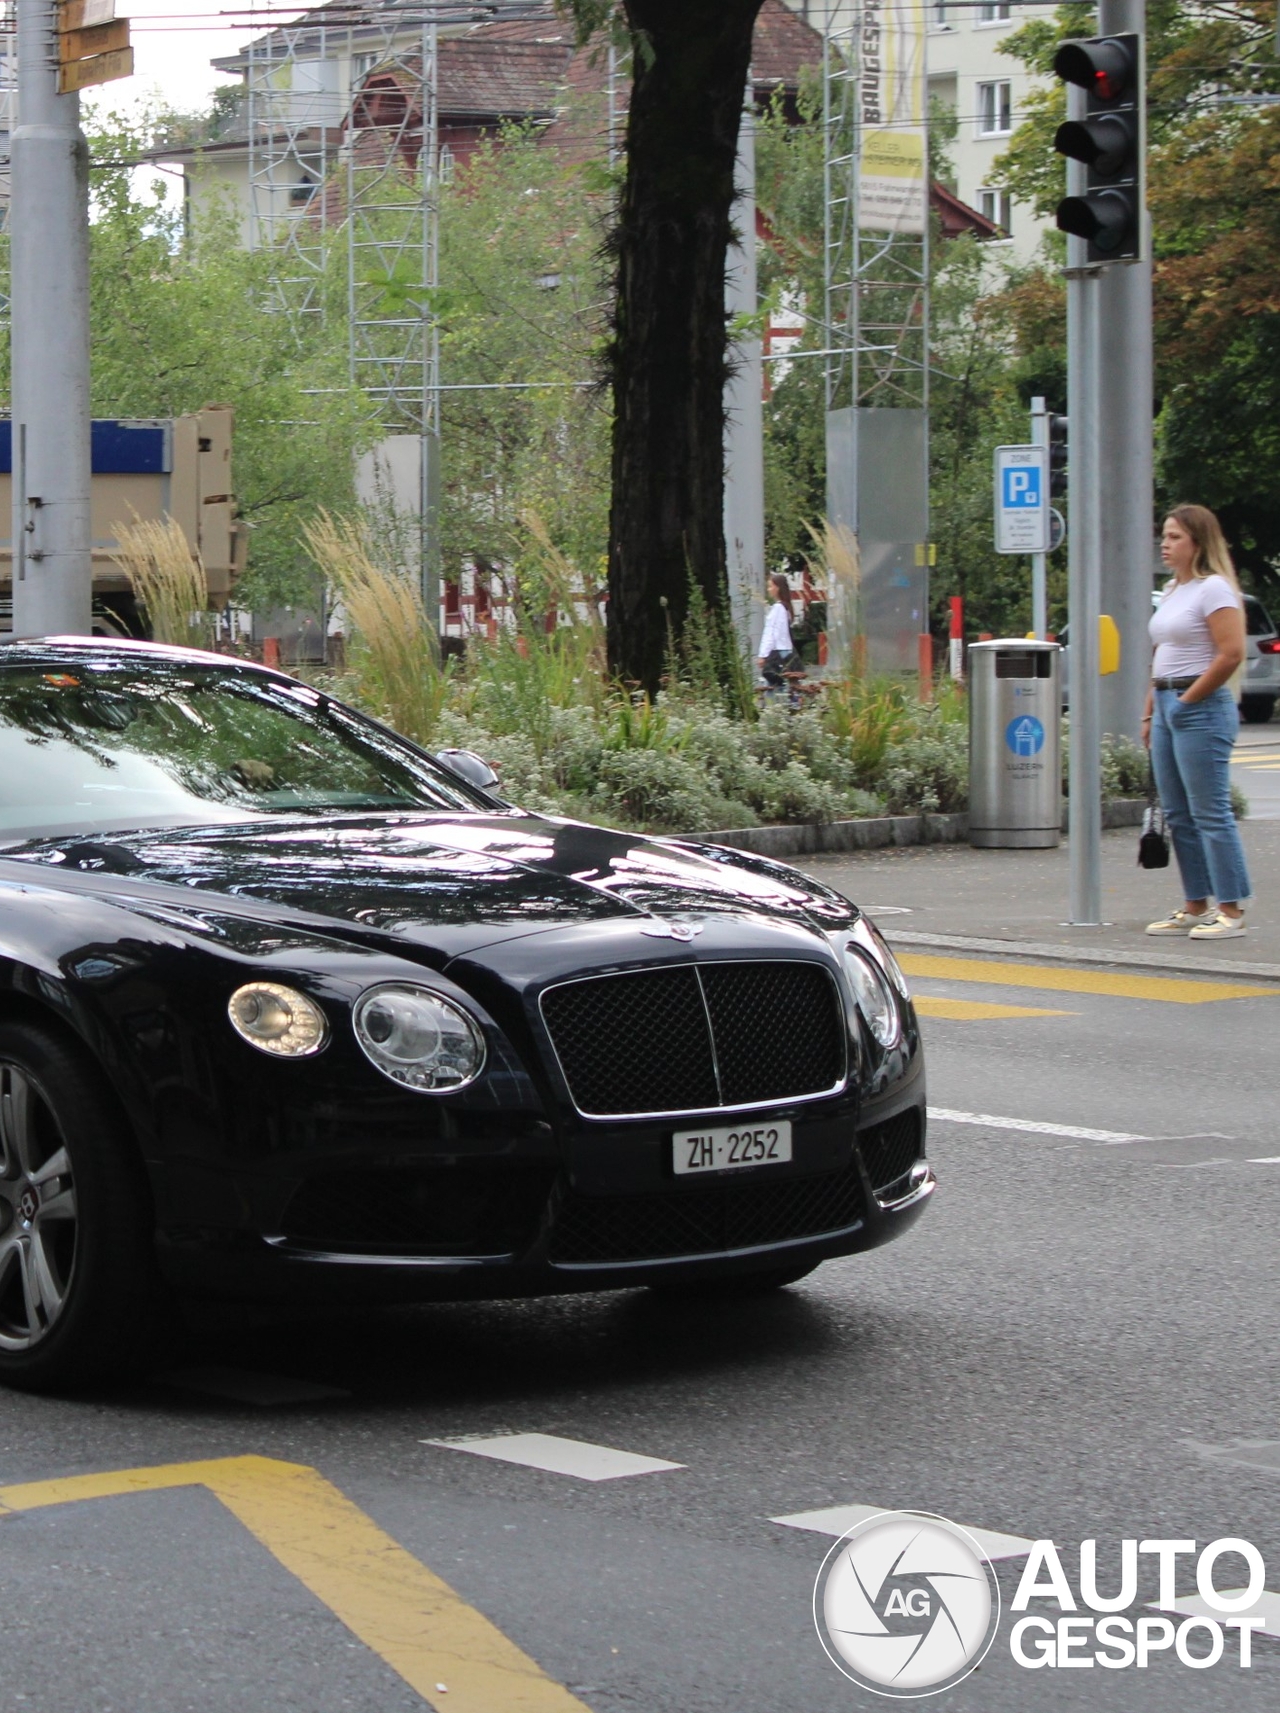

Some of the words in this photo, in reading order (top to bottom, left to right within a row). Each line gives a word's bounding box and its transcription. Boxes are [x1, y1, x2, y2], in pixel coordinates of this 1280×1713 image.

[1010, 453, 1032, 463] ZONE
[1009, 471, 1029, 502] P
[1006, 762, 1044, 771] LUZERN
